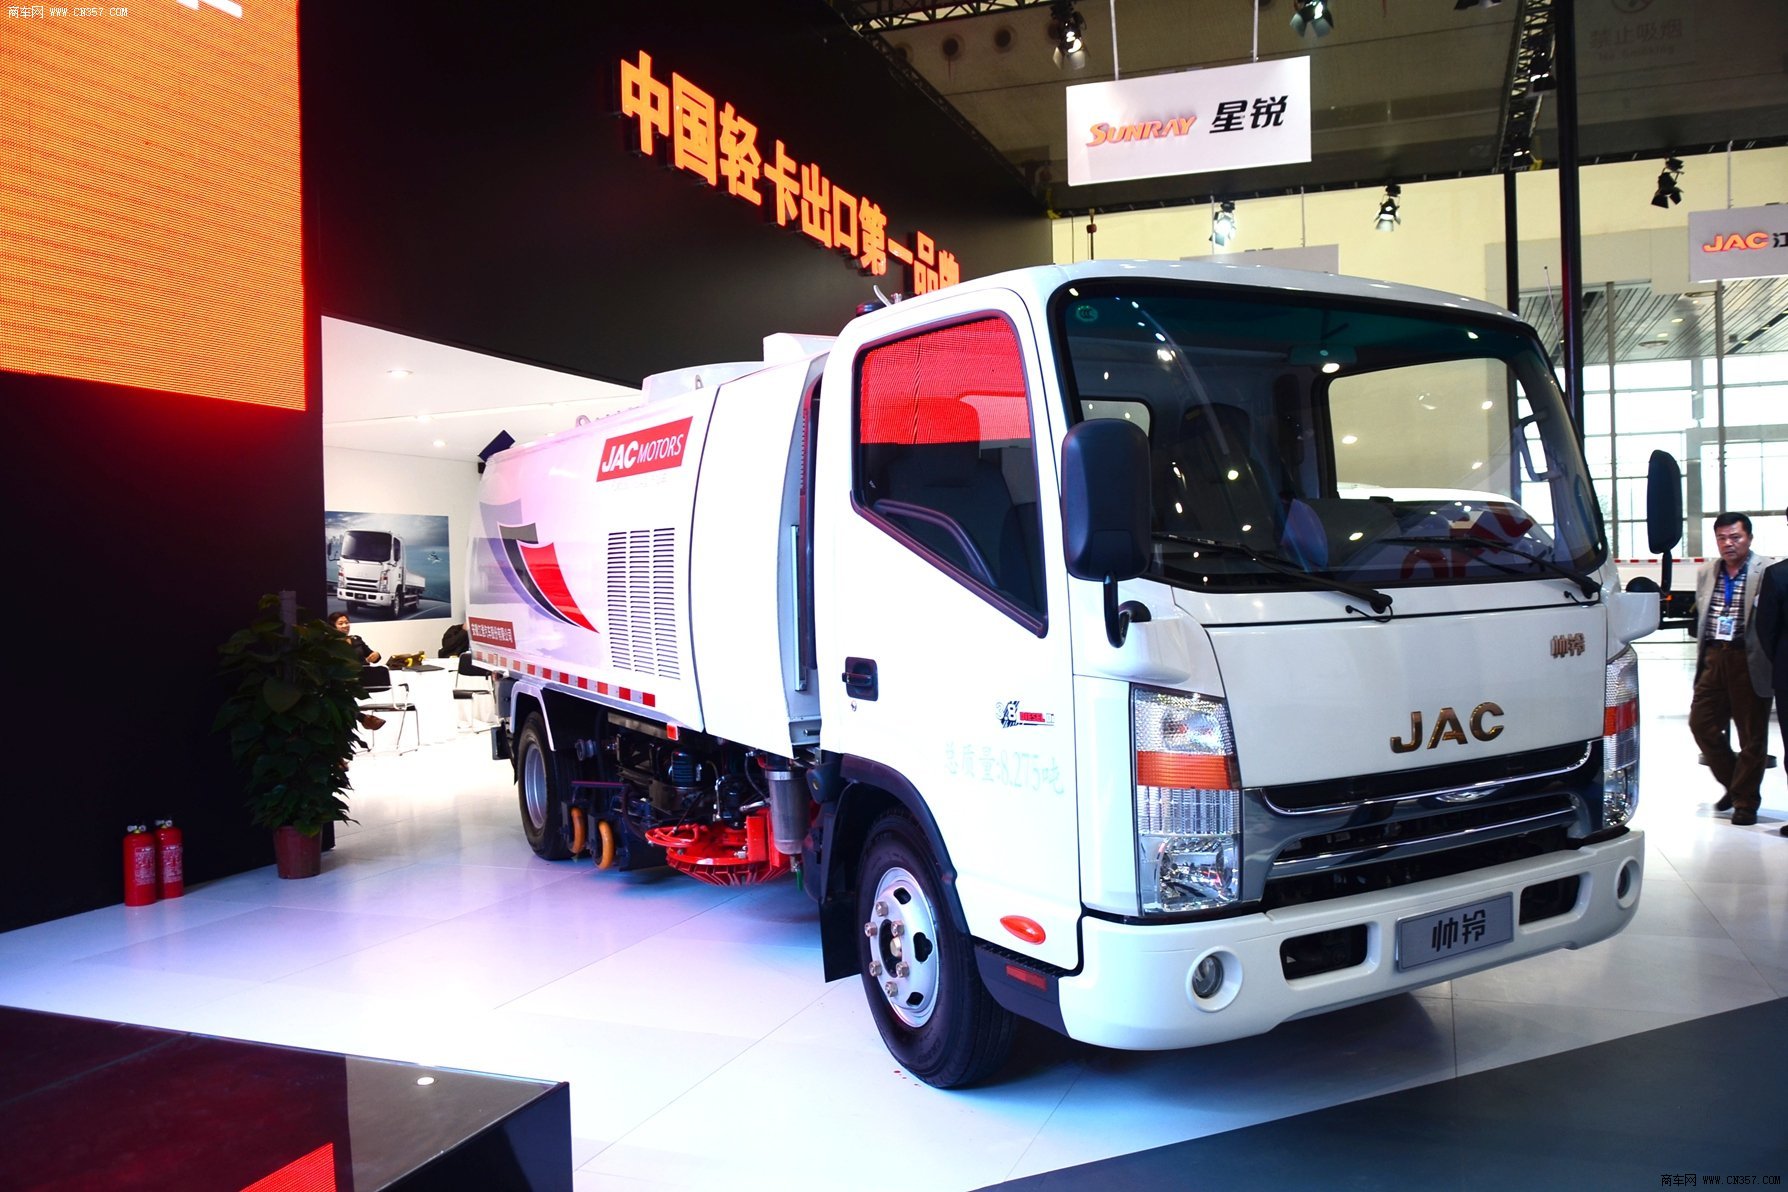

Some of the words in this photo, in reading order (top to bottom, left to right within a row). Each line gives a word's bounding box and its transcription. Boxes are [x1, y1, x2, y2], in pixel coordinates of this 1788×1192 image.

[1209, 95, 1288, 134] 星锐
[1702, 231, 1769, 252] JAC
[601, 440, 639, 473] JAC
[637, 434, 684, 464] MOTORS
[1390, 702, 1504, 753] JAC
[1431, 909, 1486, 952] 帅铃
